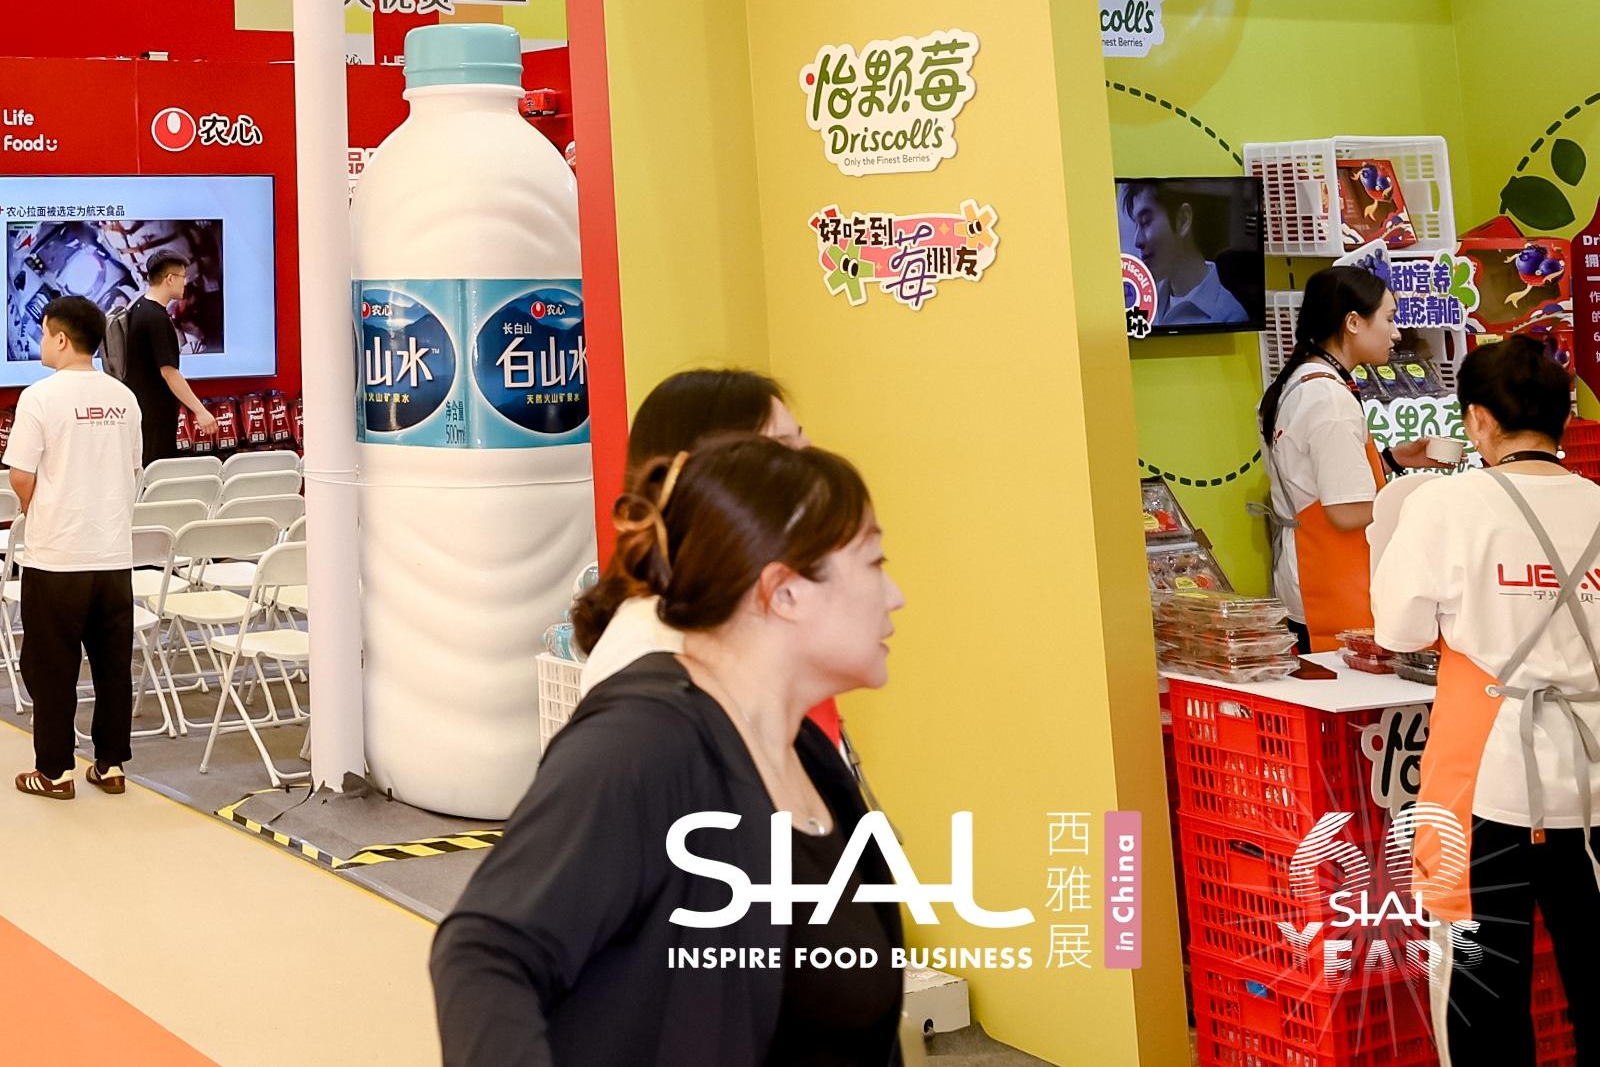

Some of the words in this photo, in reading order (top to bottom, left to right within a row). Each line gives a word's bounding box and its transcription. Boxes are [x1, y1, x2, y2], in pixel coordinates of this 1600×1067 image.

[1100, 0, 1155, 34] coll's
[1118, 38, 1143, 47] Berries
[806, 39, 970, 121] 怡颗莓
[3, 109, 34, 126] Life
[201, 115, 261, 145] 农心
[828, 118, 945, 155] Driscoll's
[3, 135, 44, 152] Food
[844, 157, 860, 167] Only
[863, 156, 875, 165] the
[877, 155, 900, 164] Finest
[903, 154, 930, 164] Berries
[6, 205, 125, 217] 农心拉面被选定为航天食品
[547, 304, 565, 315] 农心
[502, 322, 532, 334] 长白山
[366, 337, 433, 387] 山水
[365, 393, 410, 403] 火山矿泉水
